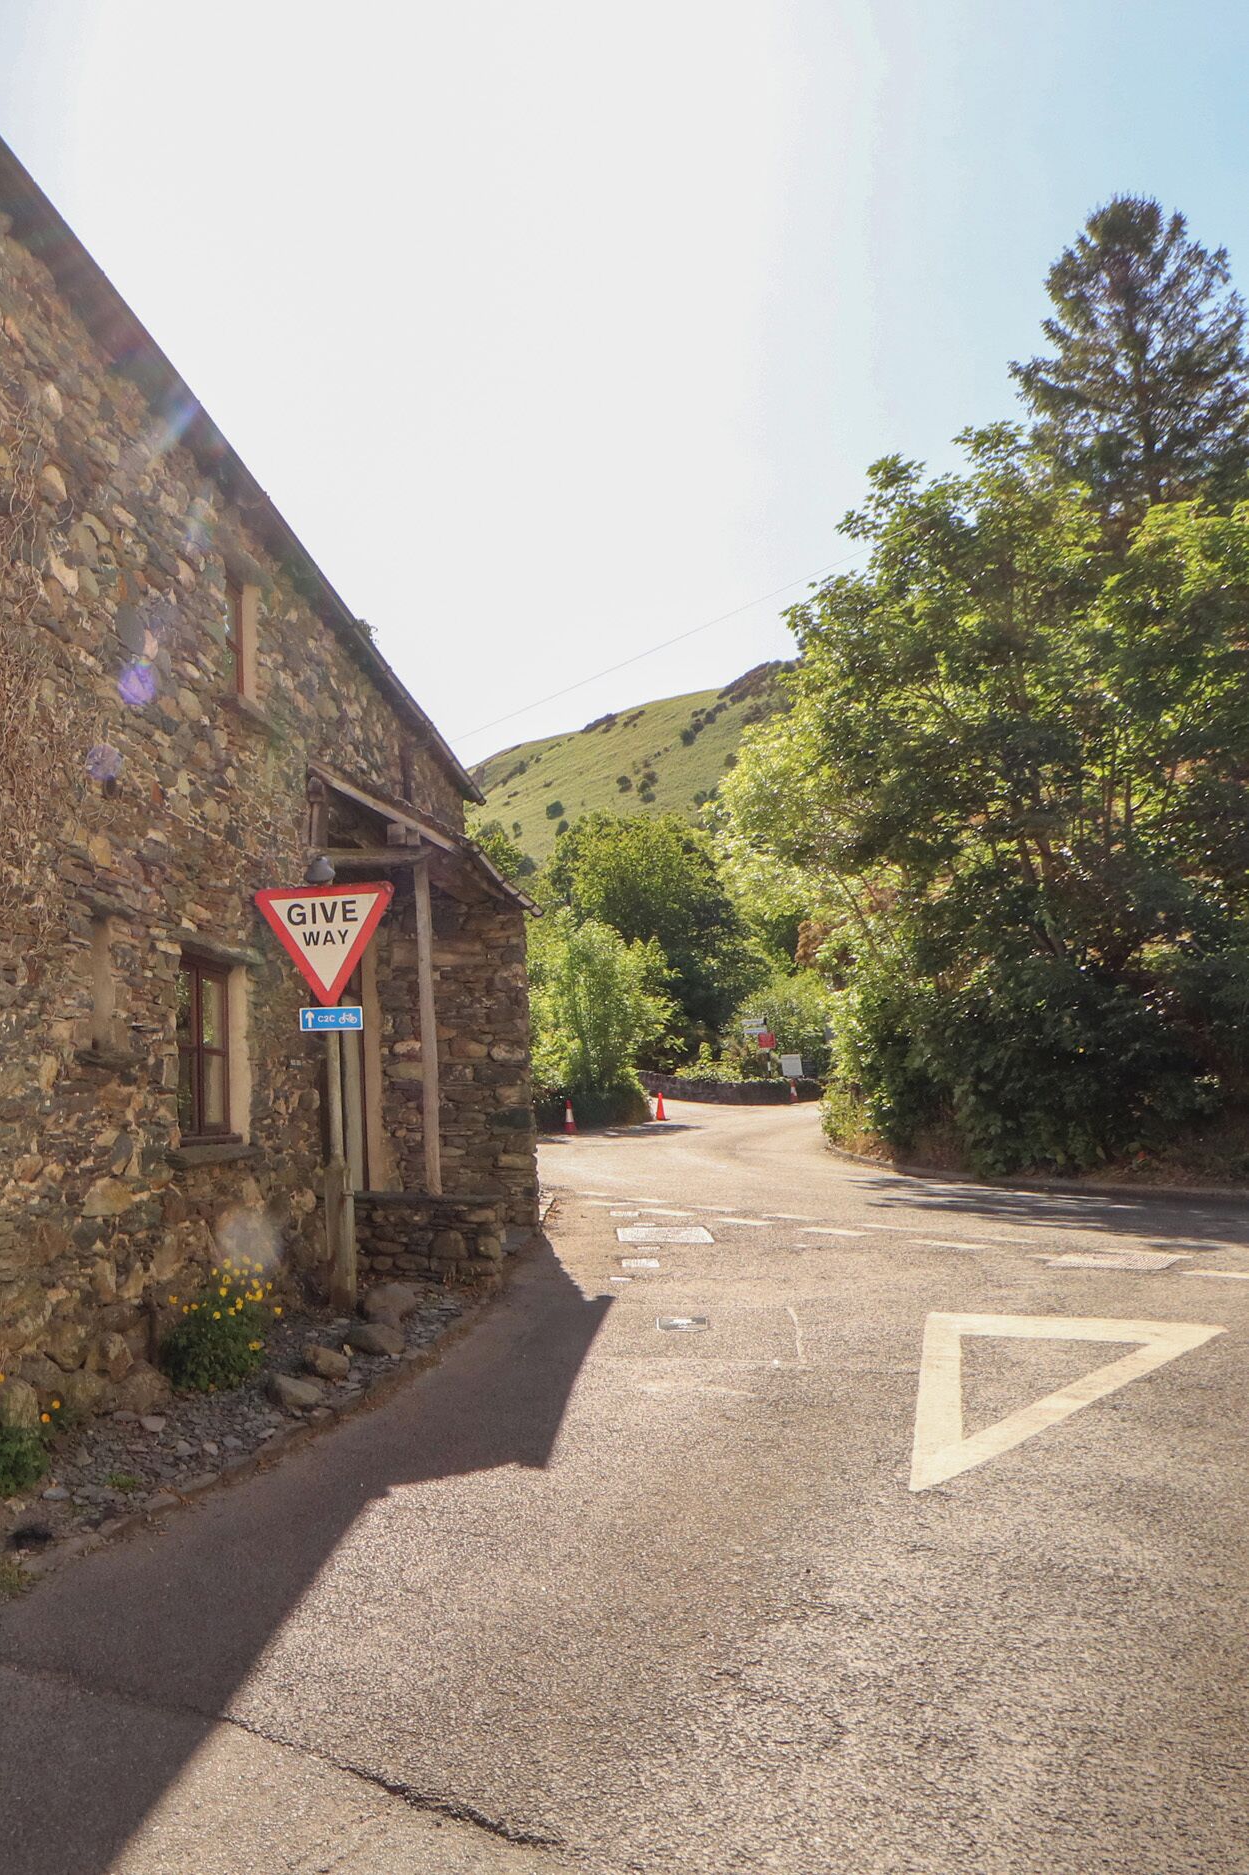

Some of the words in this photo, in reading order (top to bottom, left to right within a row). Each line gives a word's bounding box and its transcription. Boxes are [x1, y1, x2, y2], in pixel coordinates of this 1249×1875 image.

[287, 900, 358, 926] GIVE
[303, 929, 348, 946] WAY
[317, 1014, 335, 1023] C2C
